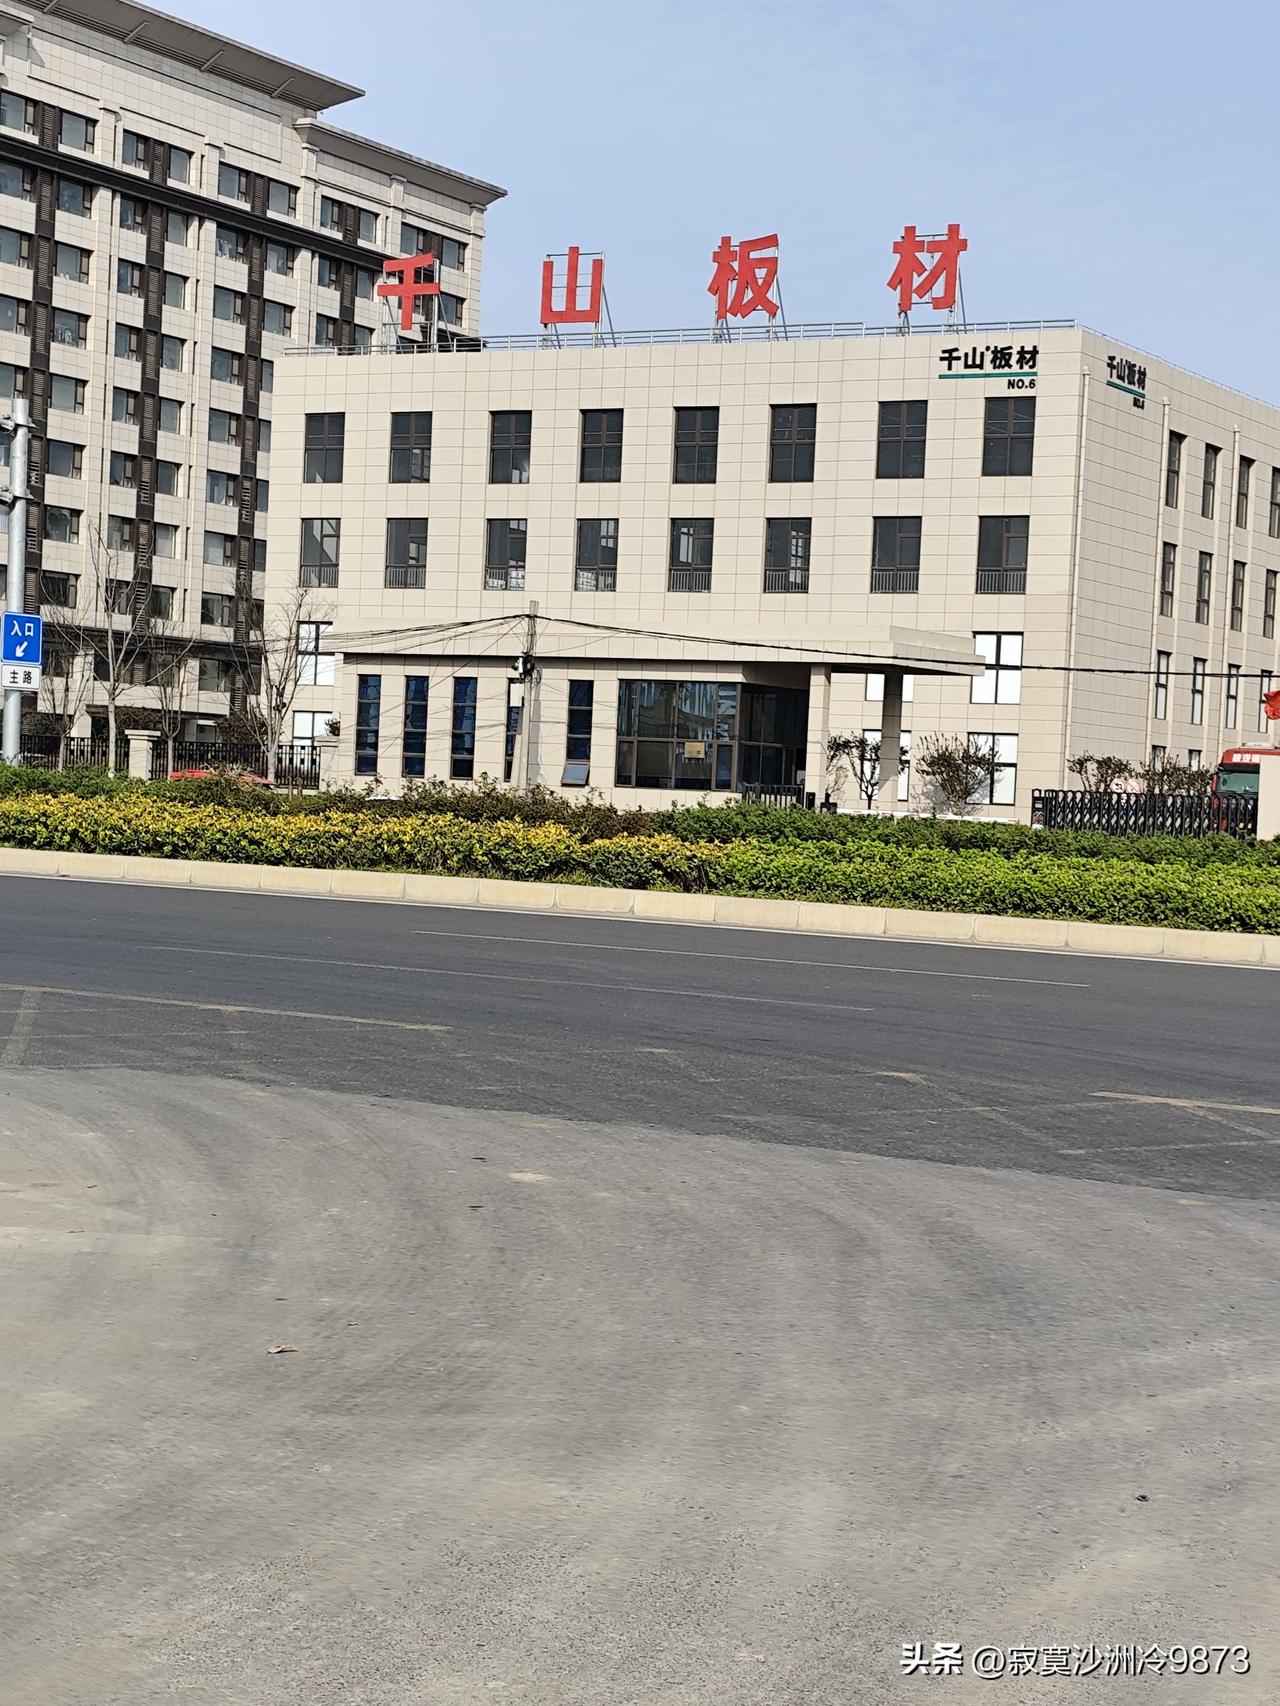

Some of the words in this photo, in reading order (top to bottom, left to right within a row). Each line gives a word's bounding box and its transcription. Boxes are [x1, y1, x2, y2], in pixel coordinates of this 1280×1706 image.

[377, 224, 968, 331] 千山板材
[1007, 378, 1036, 389] NO.6
[10, 620, 34, 637] 入口
[9, 669, 32, 684] 主路
